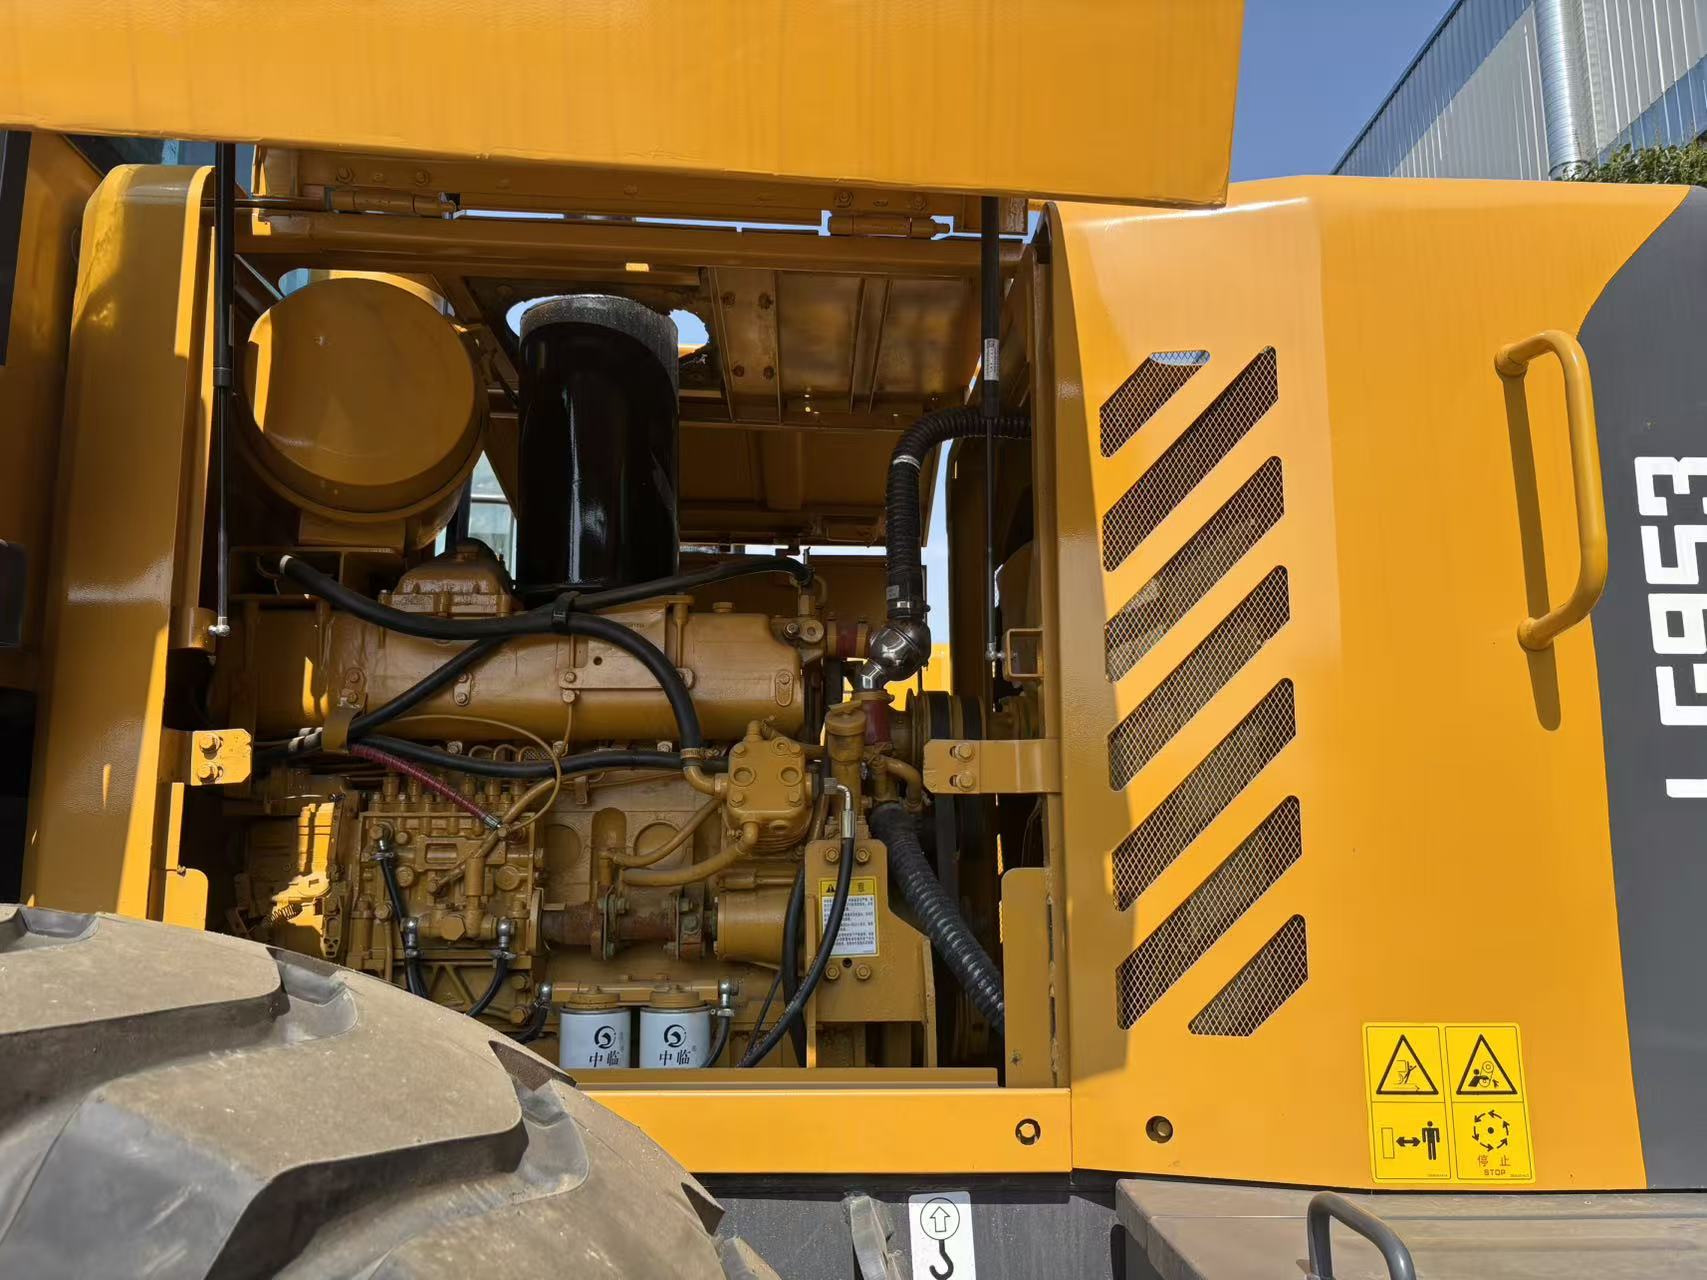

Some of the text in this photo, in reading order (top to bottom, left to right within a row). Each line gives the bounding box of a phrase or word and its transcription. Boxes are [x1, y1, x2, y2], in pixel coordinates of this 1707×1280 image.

[589, 1050, 620, 1068] 中临
[659, 1049, 691, 1066] 中临
[1484, 1168, 1506, 1176] STOP
